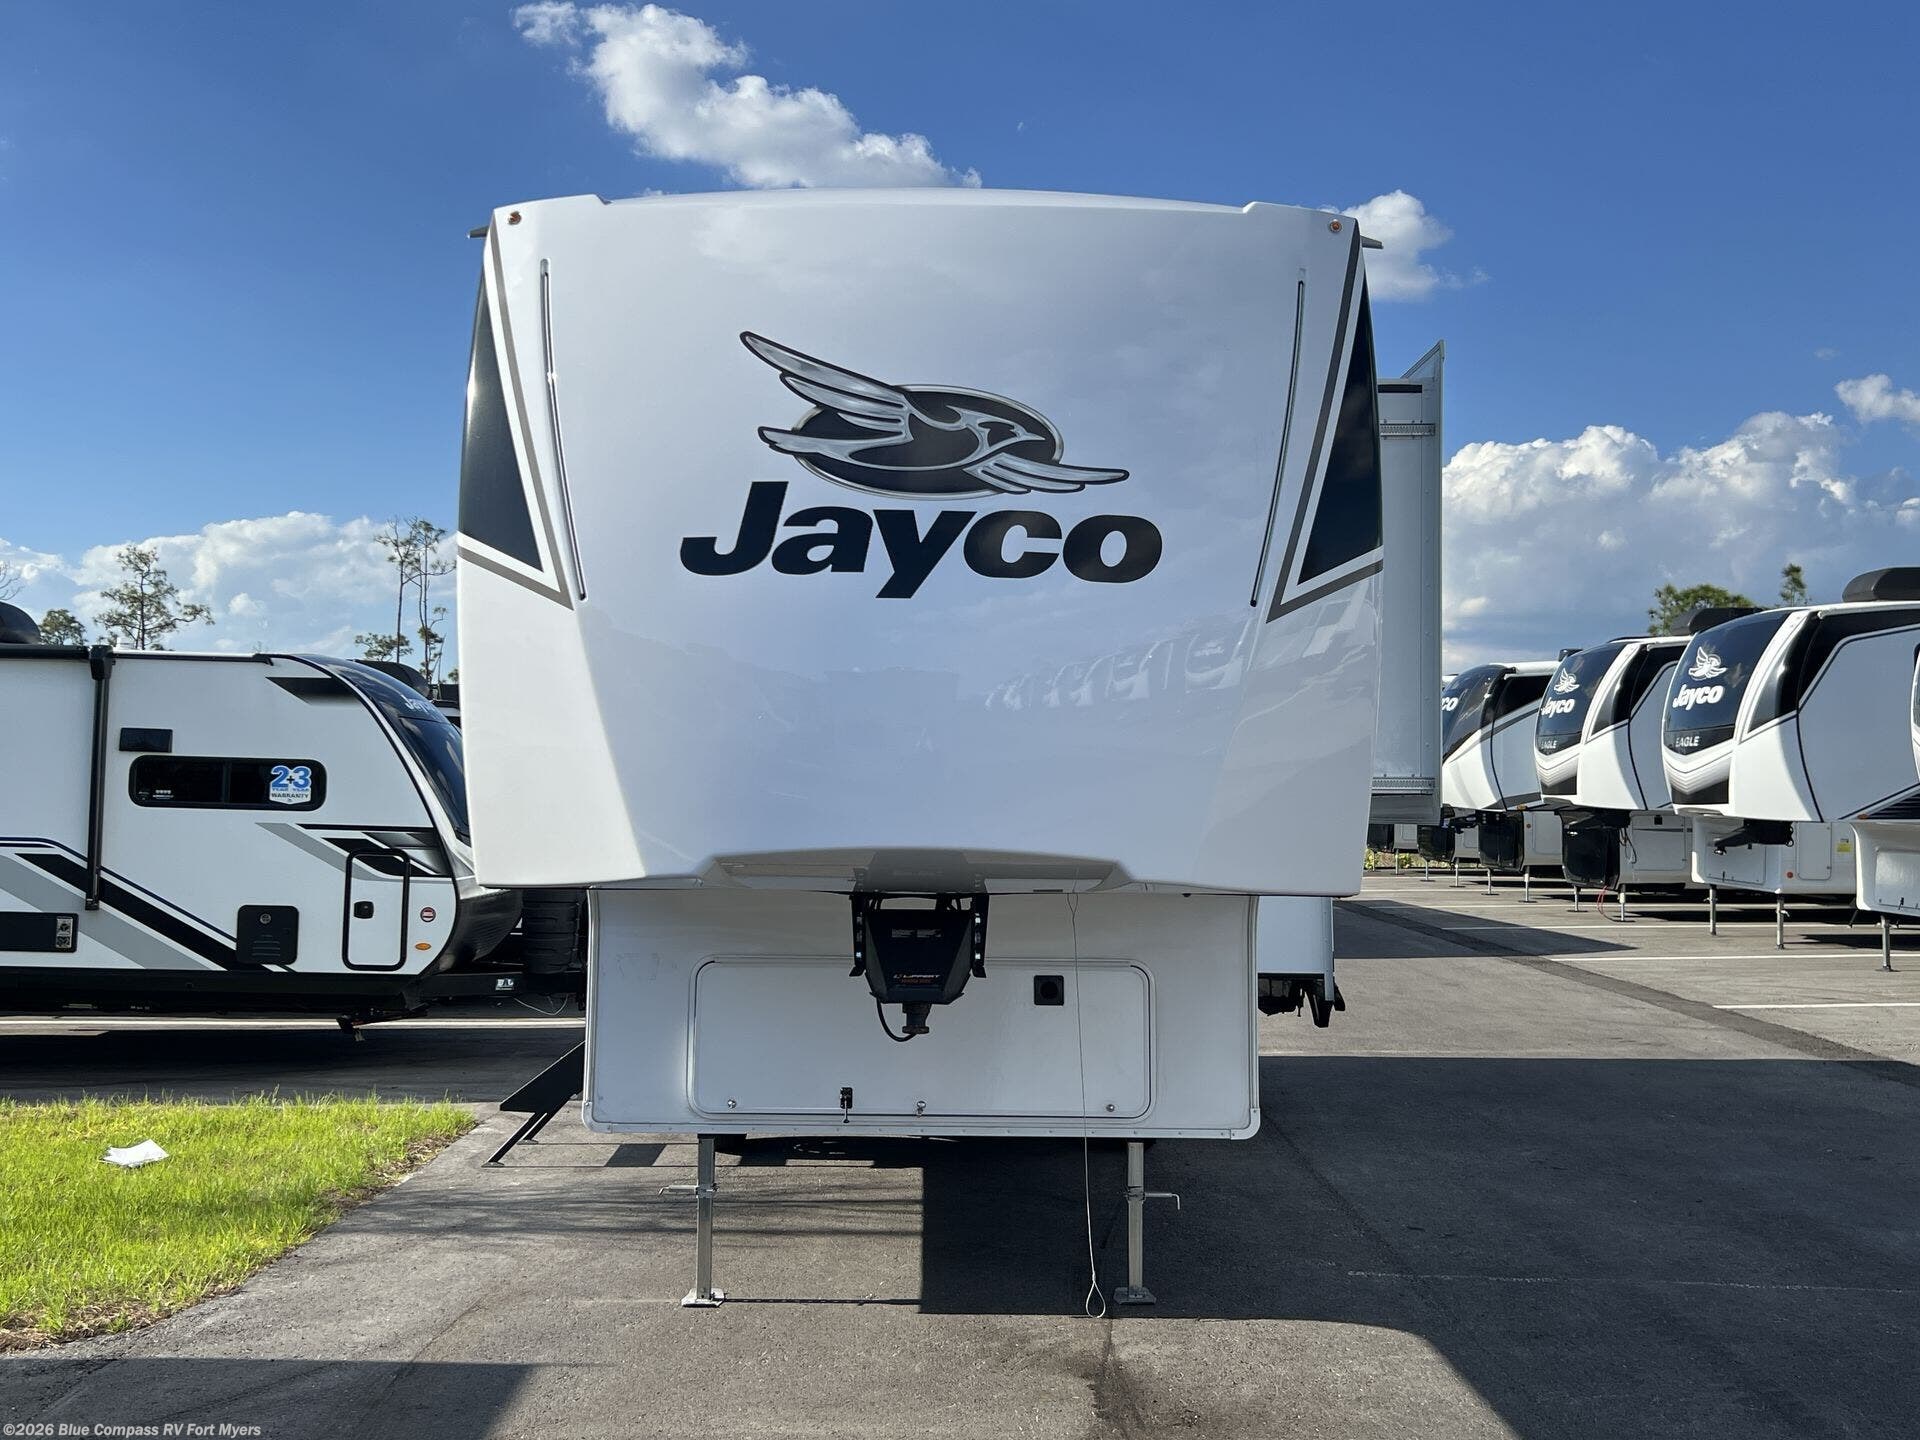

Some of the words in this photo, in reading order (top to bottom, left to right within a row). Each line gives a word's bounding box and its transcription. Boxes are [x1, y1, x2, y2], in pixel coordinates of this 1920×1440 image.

[679, 481, 1163, 600] Jayco
[1541, 697, 1576, 718] Jayco
[1672, 683, 1725, 711] Jayco
[1675, 736, 1700, 747] EAGLE
